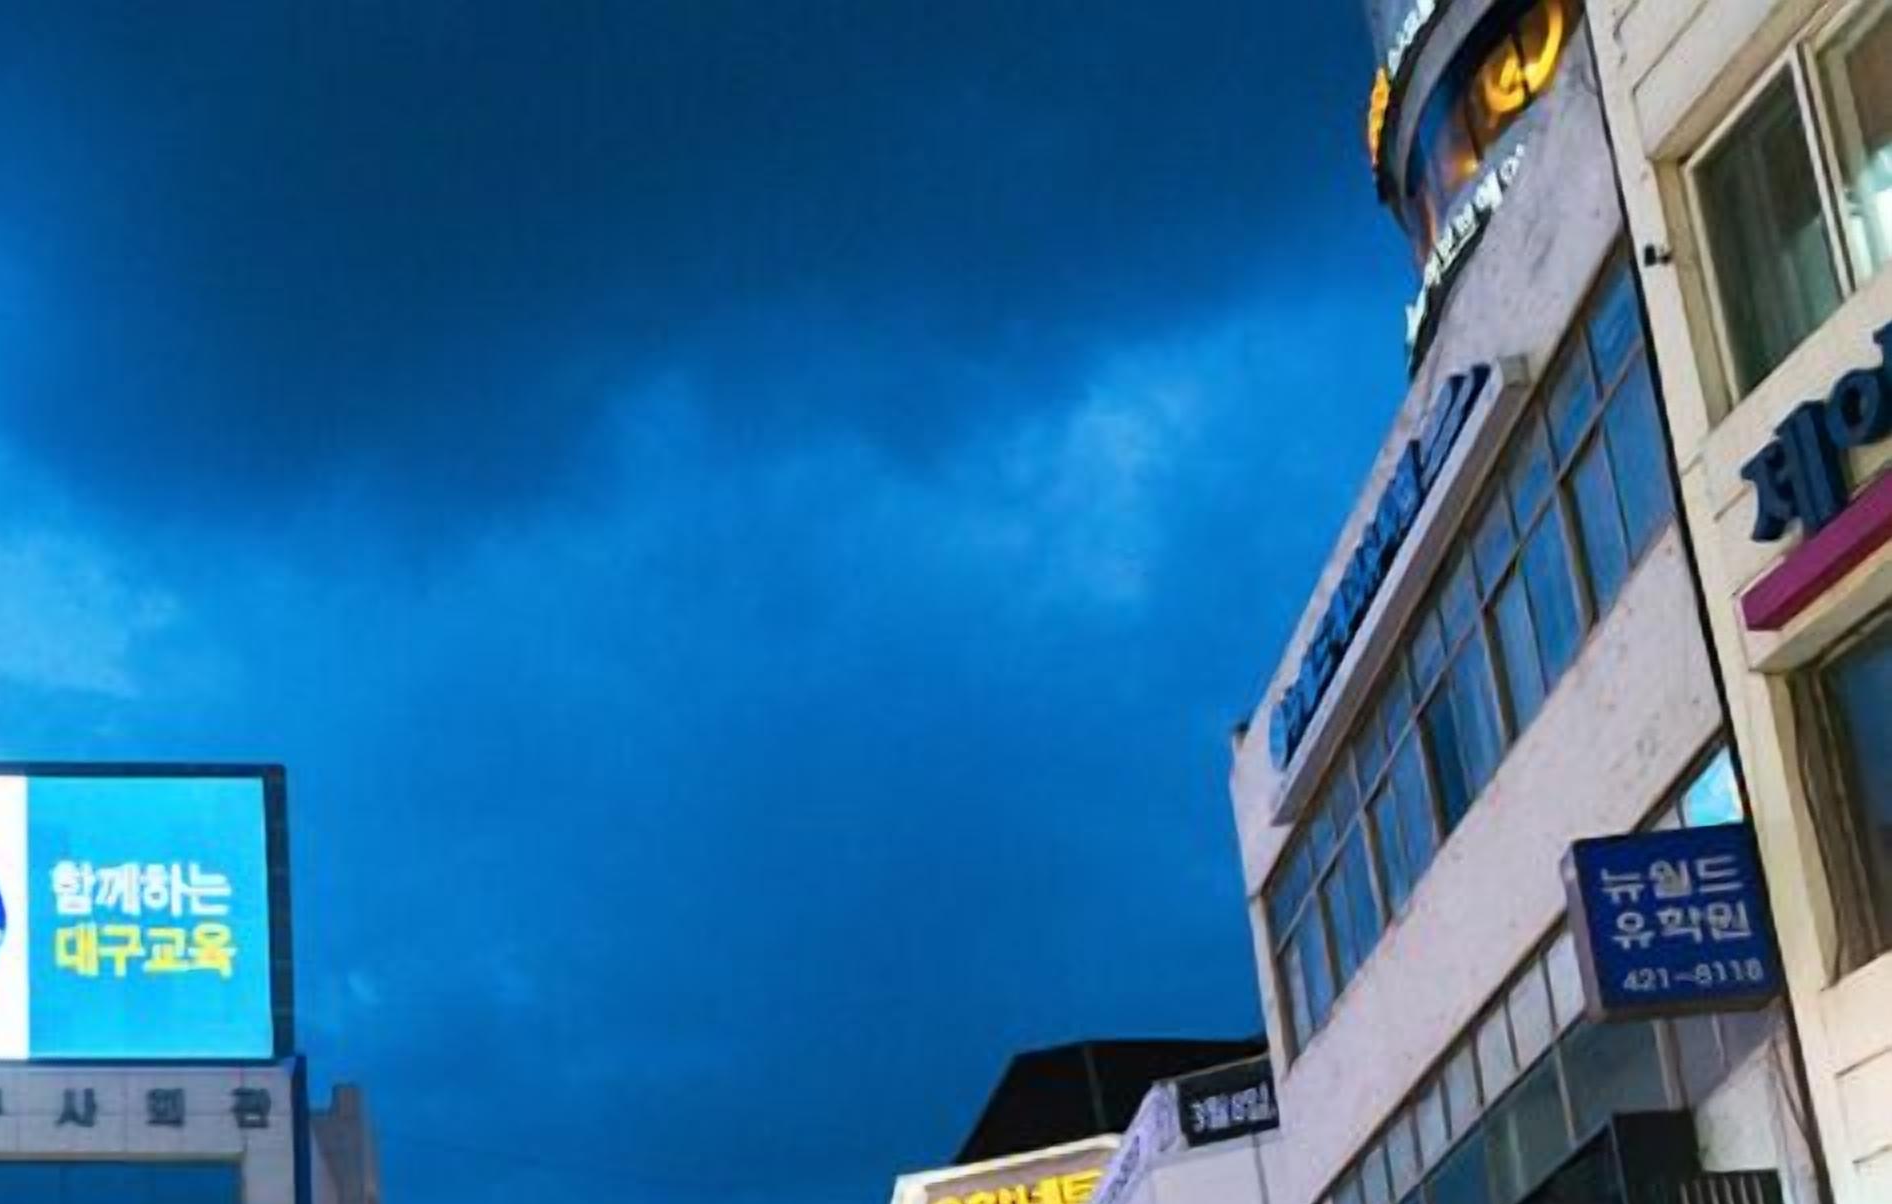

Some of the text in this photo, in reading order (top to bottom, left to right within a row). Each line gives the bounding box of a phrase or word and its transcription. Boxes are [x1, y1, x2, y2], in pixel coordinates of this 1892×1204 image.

[52, 861, 233, 915] 함께하는
[1600, 855, 1745, 904] 뉴월드
[54, 922, 237, 978] 대구교육
[1611, 901, 1753, 950] 유학원
